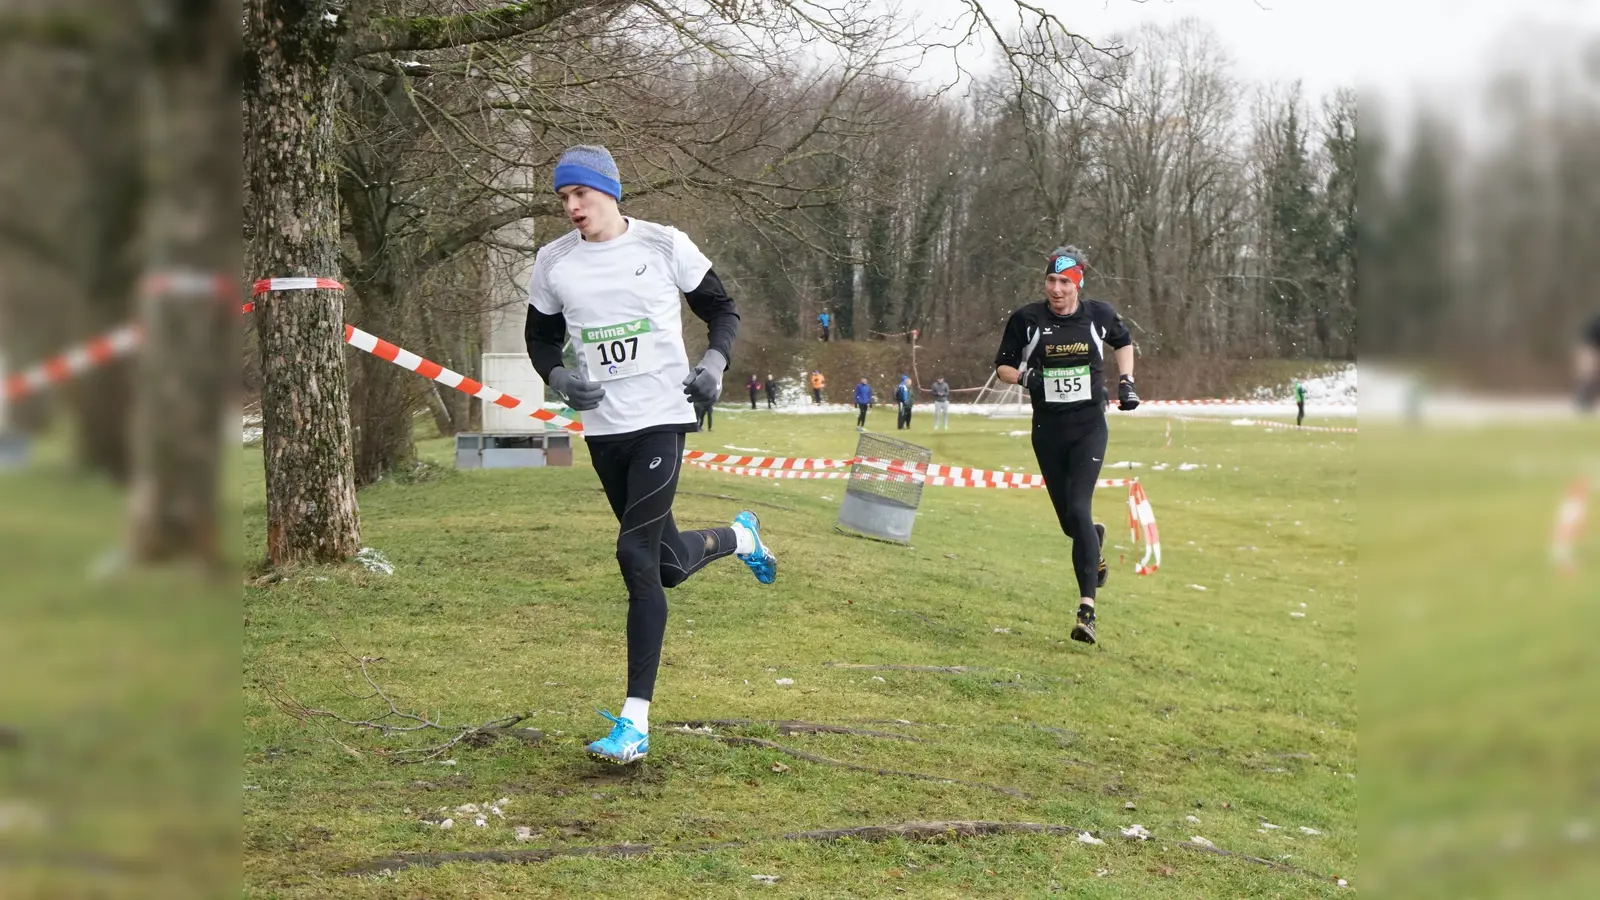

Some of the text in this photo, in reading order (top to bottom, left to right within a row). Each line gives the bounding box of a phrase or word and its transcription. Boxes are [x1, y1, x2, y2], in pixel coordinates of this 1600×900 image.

[587, 326, 625, 340] erima
[597, 337, 638, 366] 107
[1048, 368, 1075, 377] erima
[1053, 377, 1082, 393] 155
